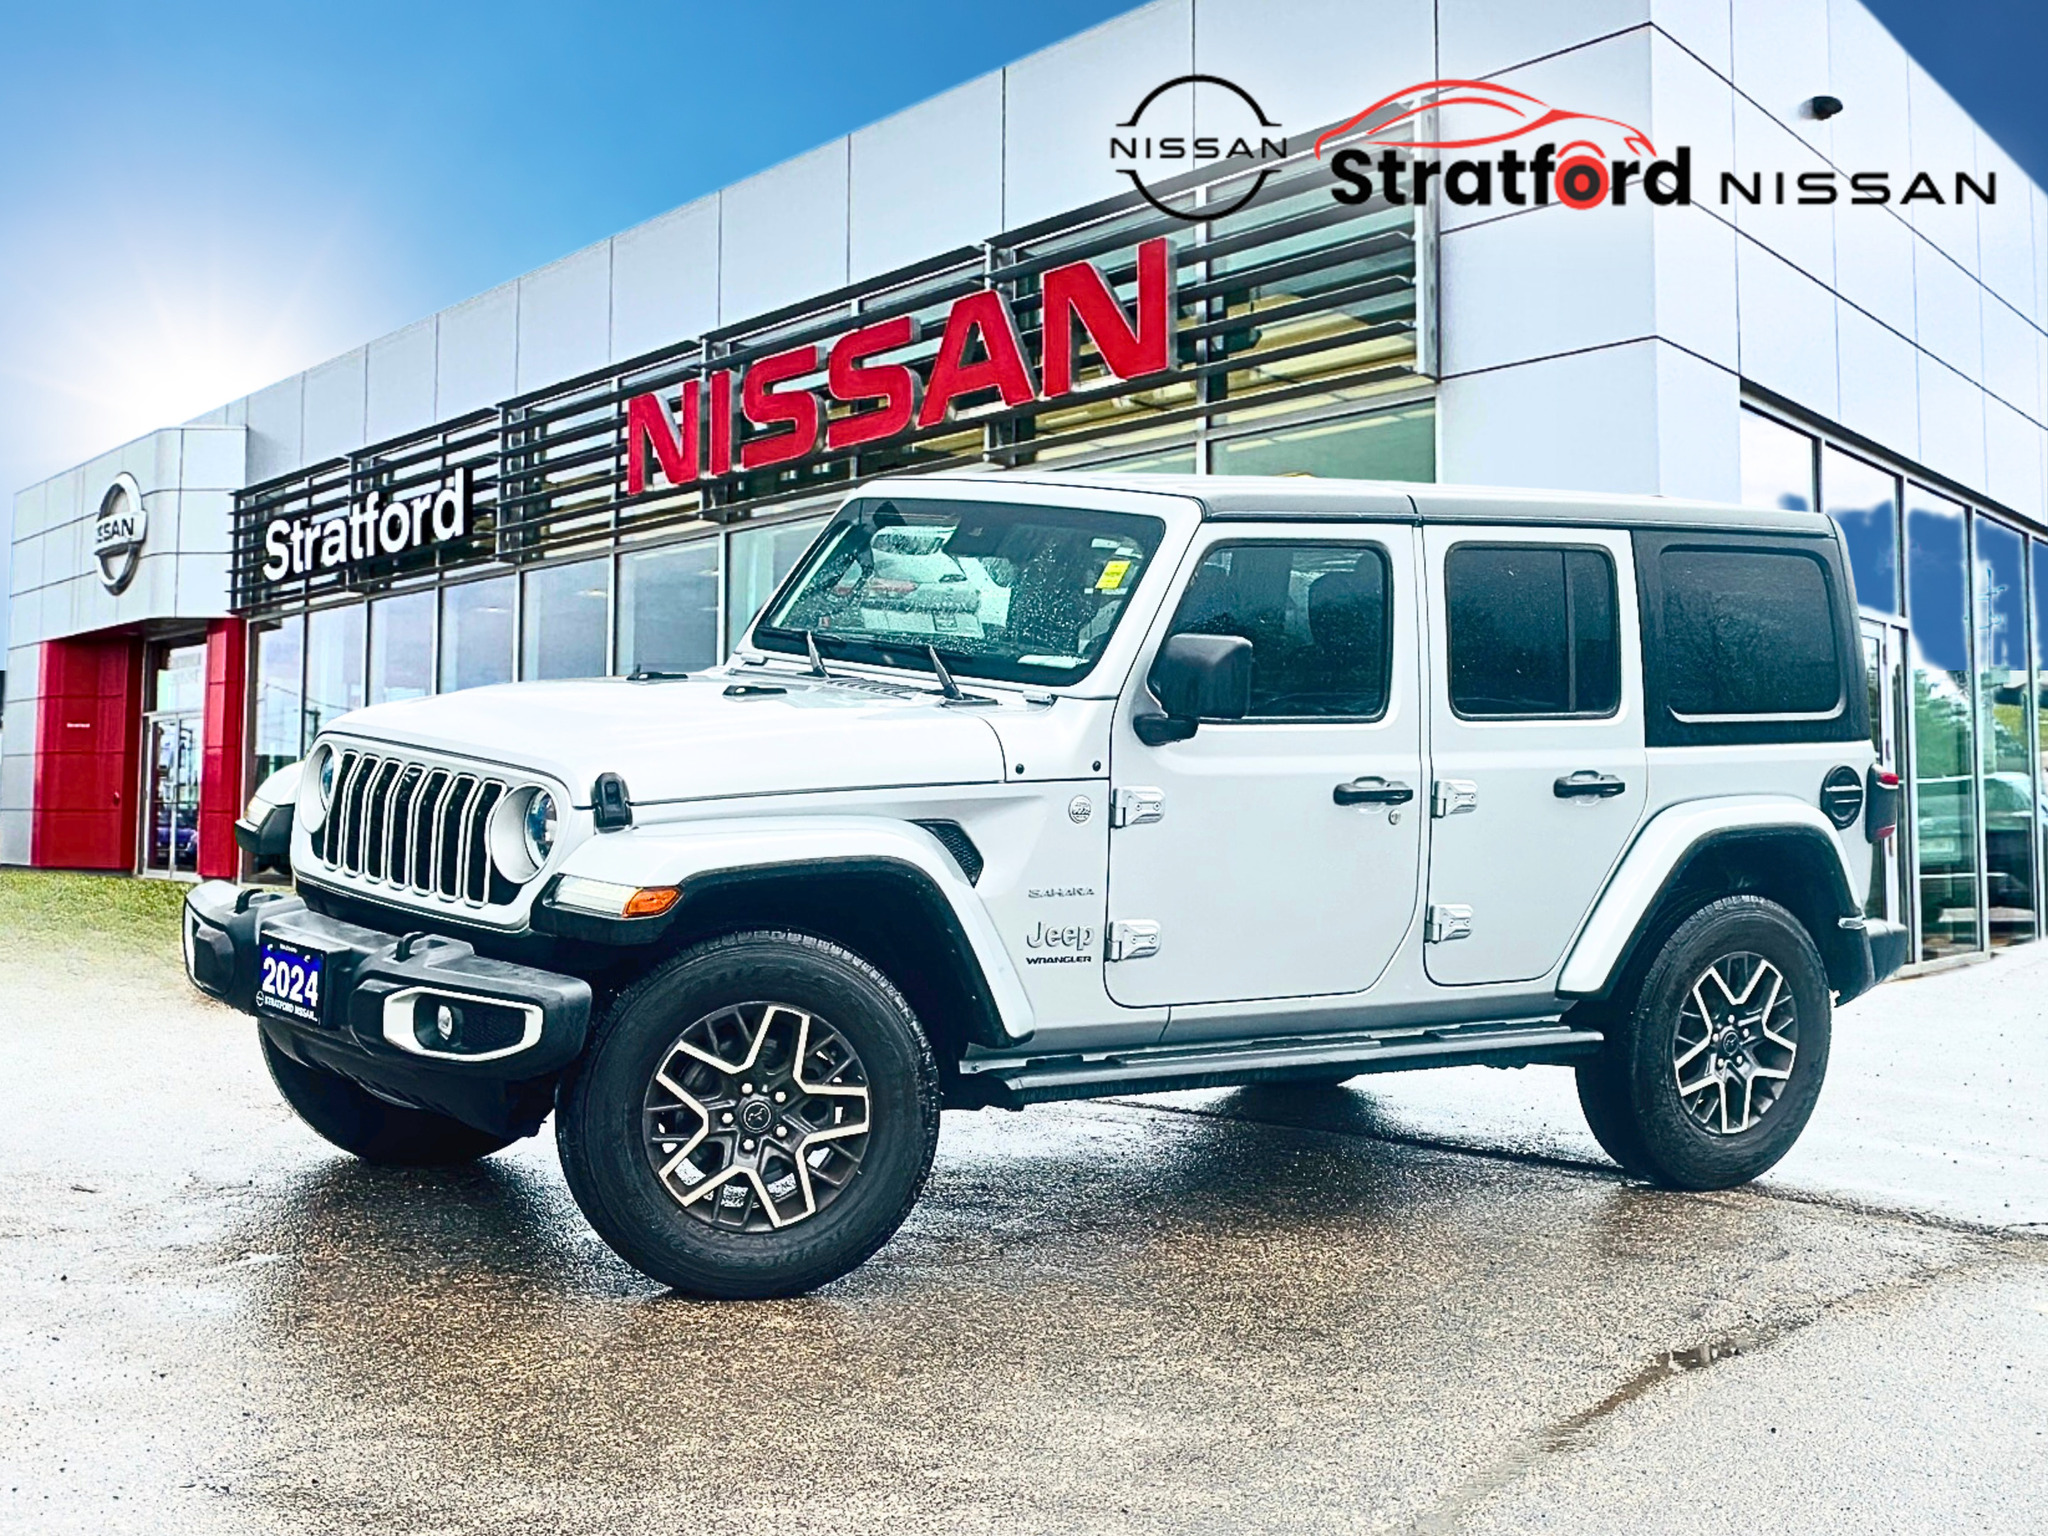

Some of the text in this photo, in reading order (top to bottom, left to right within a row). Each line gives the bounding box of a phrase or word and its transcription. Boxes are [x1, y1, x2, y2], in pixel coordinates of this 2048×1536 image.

[626, 236, 1177, 497] NISSAN
[262, 467, 465, 582] Stratford
[1025, 955, 1092, 965] WRANGLER
[1026, 921, 1095, 952] Jeep
[262, 956, 319, 1007] 2024
